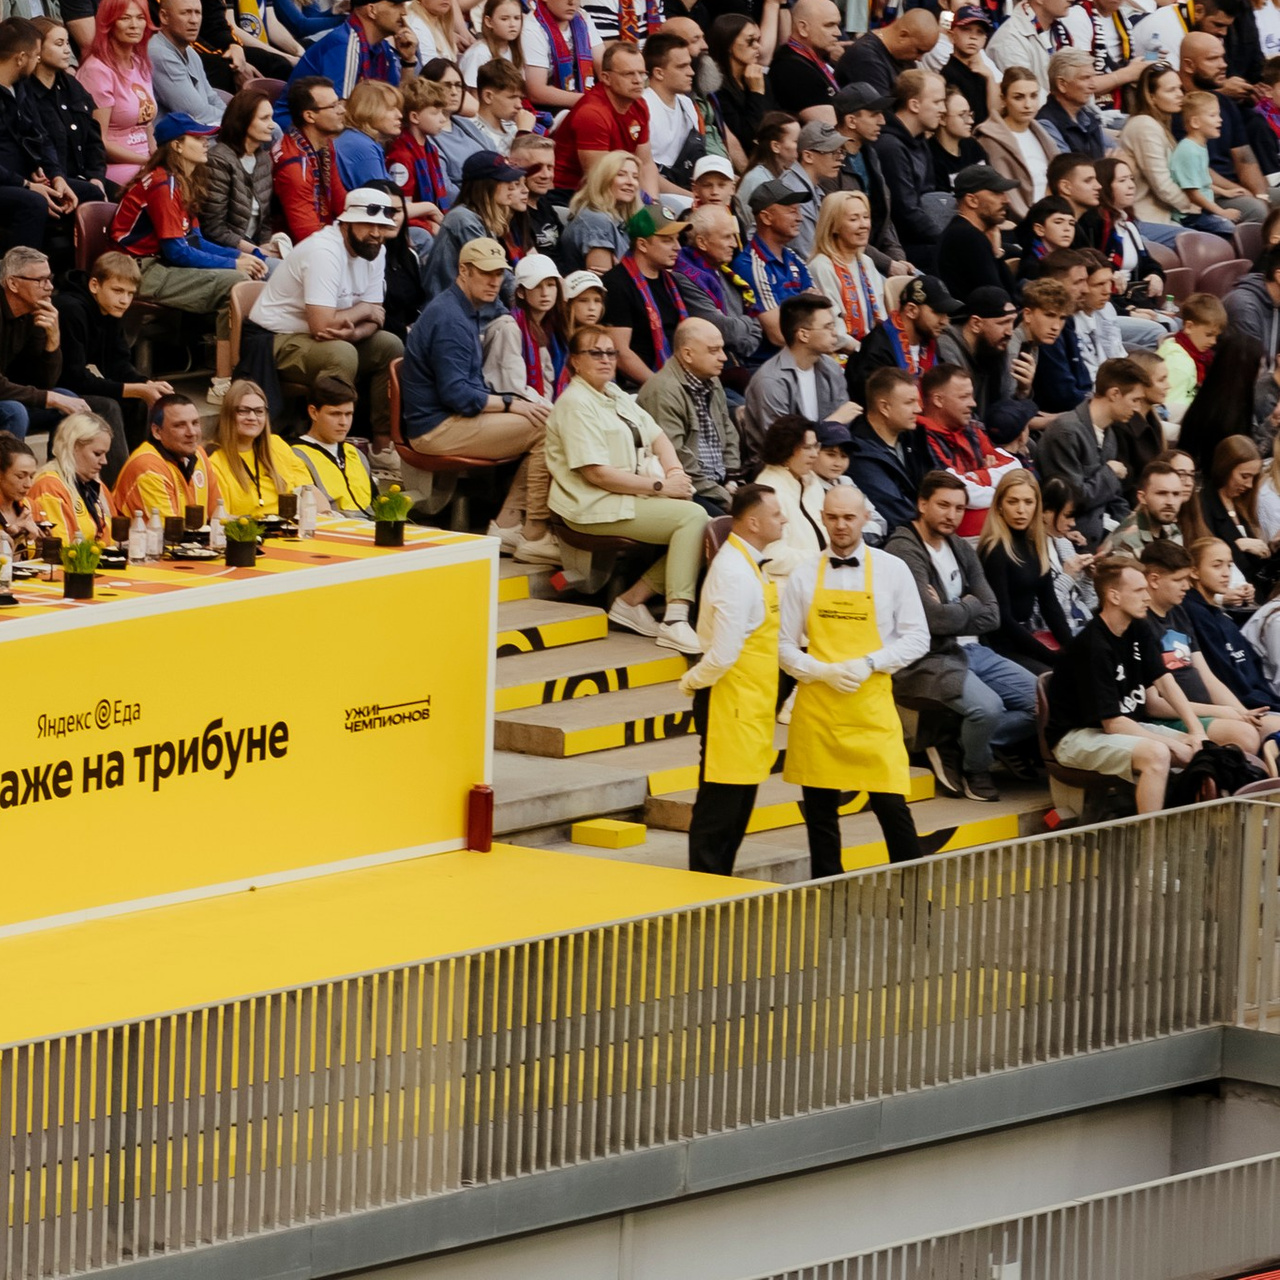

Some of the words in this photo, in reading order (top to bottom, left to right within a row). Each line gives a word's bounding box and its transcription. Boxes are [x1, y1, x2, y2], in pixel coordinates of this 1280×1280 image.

[37, 711, 93, 739] Яндекс
[113, 699, 142, 727] Еда
[345, 708, 430, 734] ЧЕМПИОНОВ
[82, 750, 125, 794] на
[133, 716, 290, 793] трибуне
